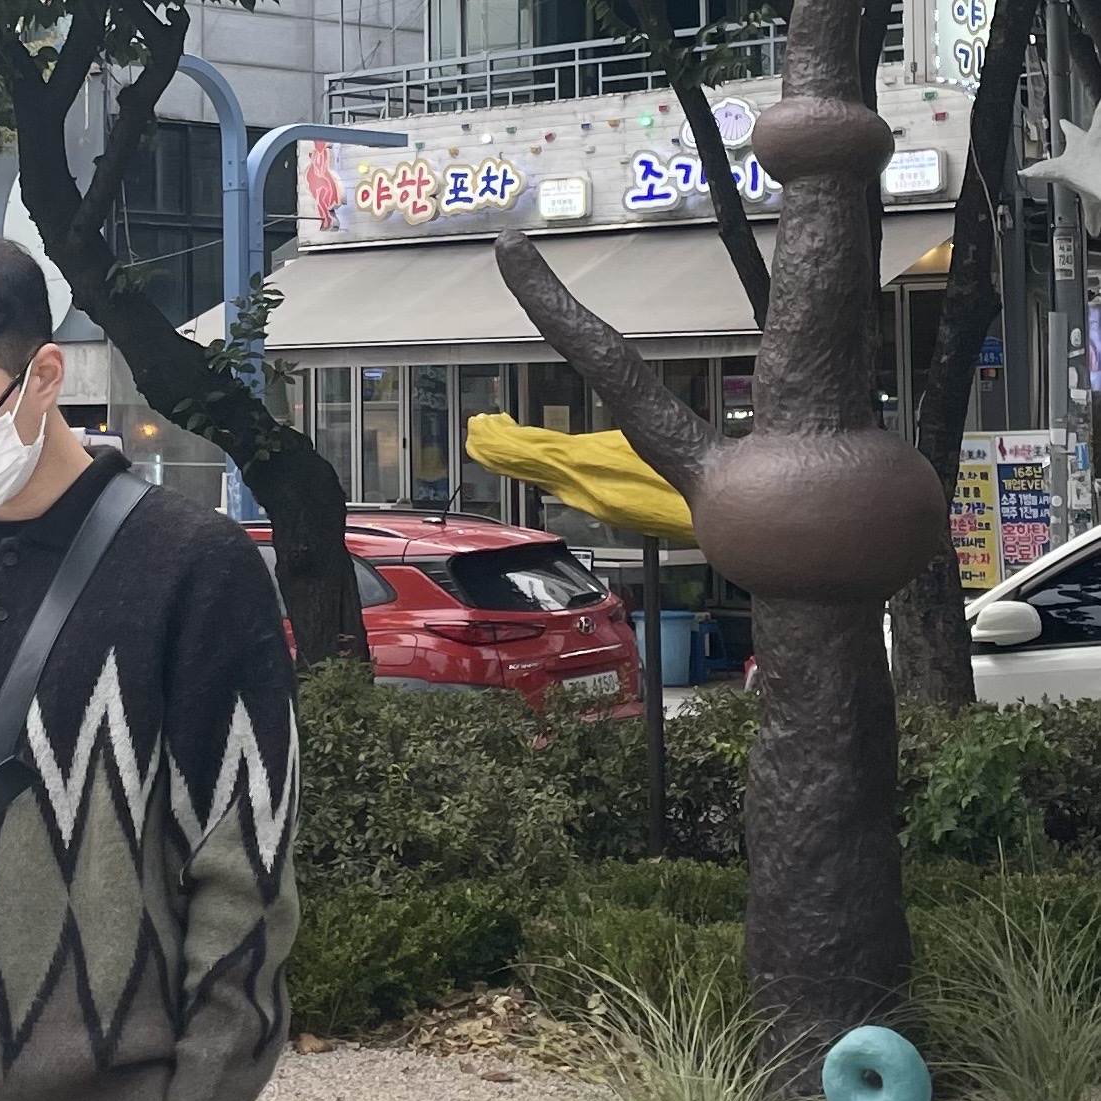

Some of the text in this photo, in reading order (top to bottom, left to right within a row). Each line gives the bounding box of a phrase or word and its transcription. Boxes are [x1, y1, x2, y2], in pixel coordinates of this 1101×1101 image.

[360, 165, 515, 215] 야한 포차
[1001, 494, 1017, 506] 소주
[1002, 523, 1048, 544] 홍합탕
